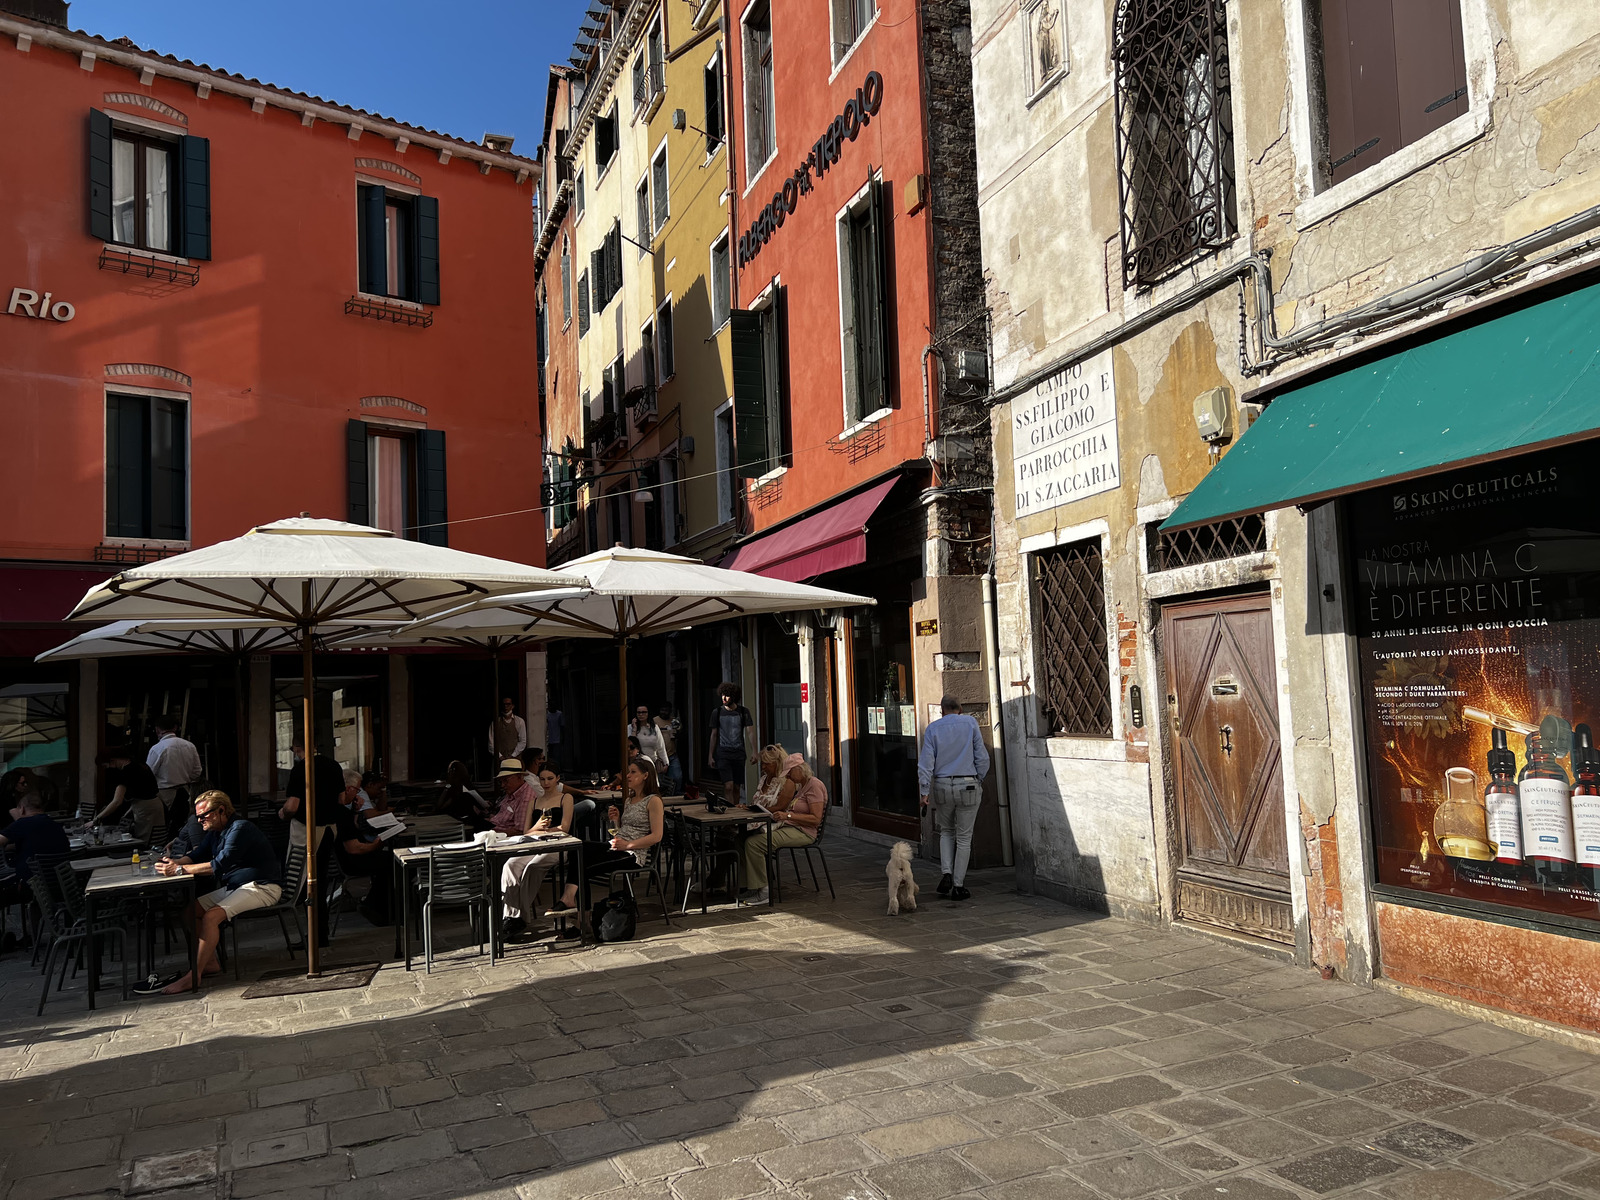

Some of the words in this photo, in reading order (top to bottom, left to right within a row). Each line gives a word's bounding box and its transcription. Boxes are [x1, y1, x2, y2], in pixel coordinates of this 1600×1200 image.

[738, 178, 797, 268] ALBERGO
[812, 71, 883, 178] TIEPOLO
[8, 287, 76, 322] Rio
[1036, 362, 1083, 397] CAMPO
[1015, 383, 1090, 430] SS.FILIPPO
[1100, 372, 1110, 393] E
[1030, 405, 1095, 446] GIACOMO
[1019, 433, 1108, 481] PARROCCHIA
[1016, 491, 1030, 510] DI
[1035, 461, 1118, 503] S.ZACCARIA
[1440, 495, 1506, 512] PROFESSIONAL
[1511, 485, 1558, 500] SKINCARE
[1365, 548, 1378, 562] LA
[1382, 540, 1430, 560] NOSTRA
[1366, 549, 1498, 591] VITAMINA
[1514, 543, 1539, 572] C
[1370, 590, 1380, 621] È
[1392, 578, 1543, 620] DIFFERENTE
[1371, 630, 1381, 639] 30
[1383, 628, 1406, 638] ANNI
[1408, 627, 1419, 637] DI
[1421, 624, 1459, 635] RICERCA
[1462, 622, 1473, 632] IN
[1477, 620, 1504, 631] OGNI
[1507, 617, 1549, 628] GOCCIA
[1420, 648, 1445, 658] NEGLI
[1447, 645, 1517, 656] ANTIOSSIDANTI
